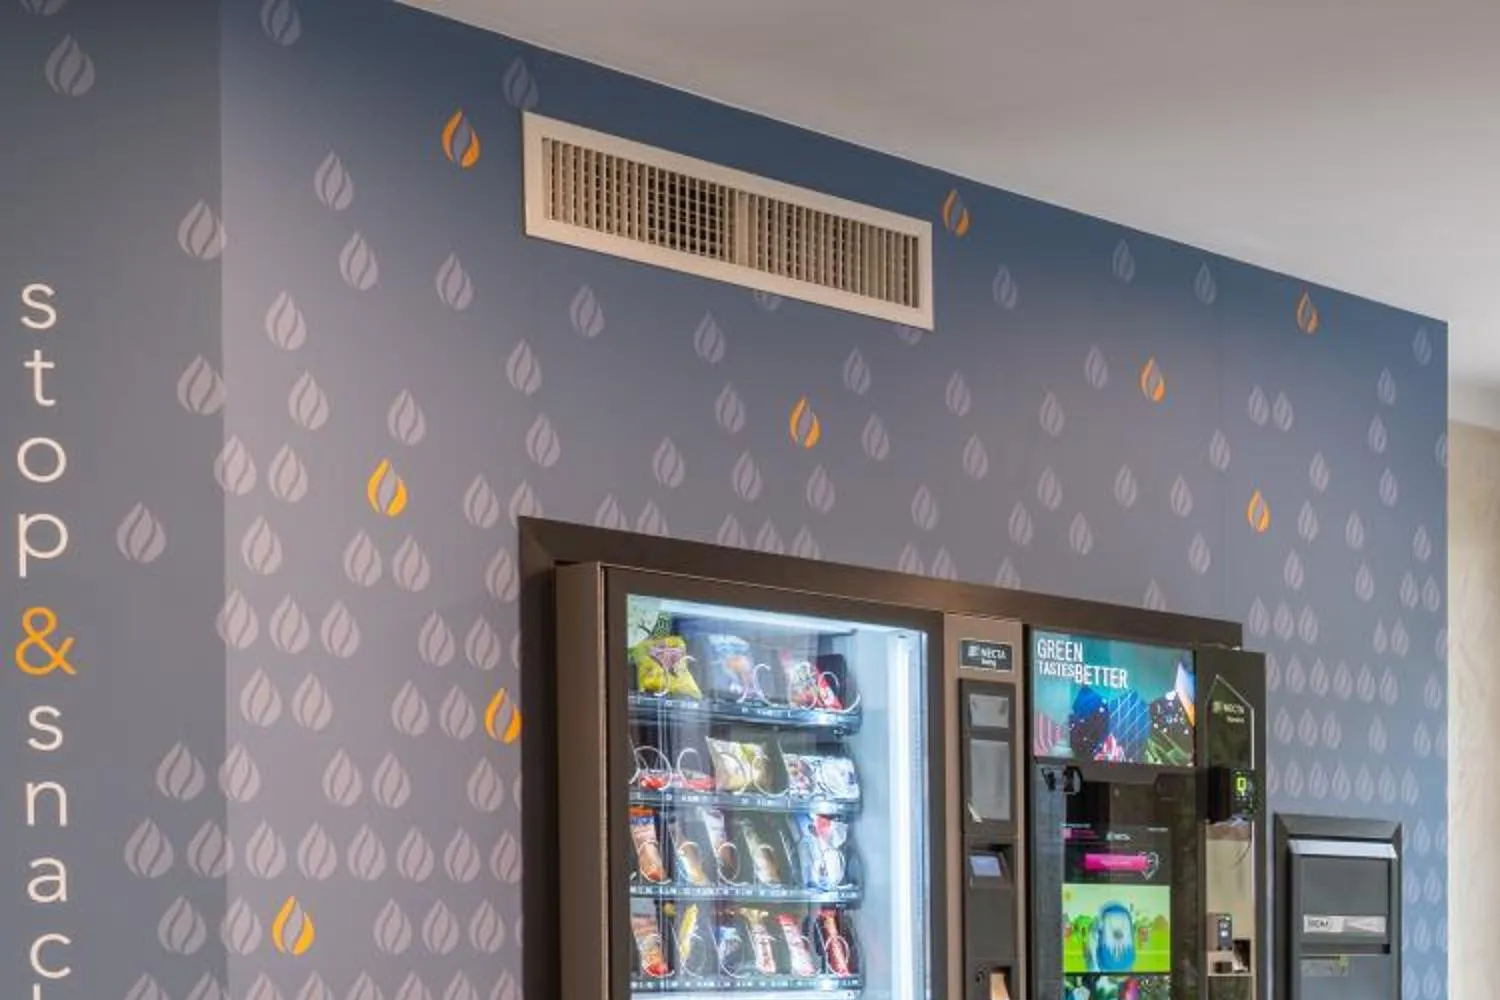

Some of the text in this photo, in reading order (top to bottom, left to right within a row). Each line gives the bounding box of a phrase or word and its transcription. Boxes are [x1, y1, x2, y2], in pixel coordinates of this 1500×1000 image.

[16, 282, 70, 578] stop
[15, 606, 76, 676] &
[1037, 637, 1083, 662] GREEN
[1039, 661, 1128, 689] TASTES BETTER
